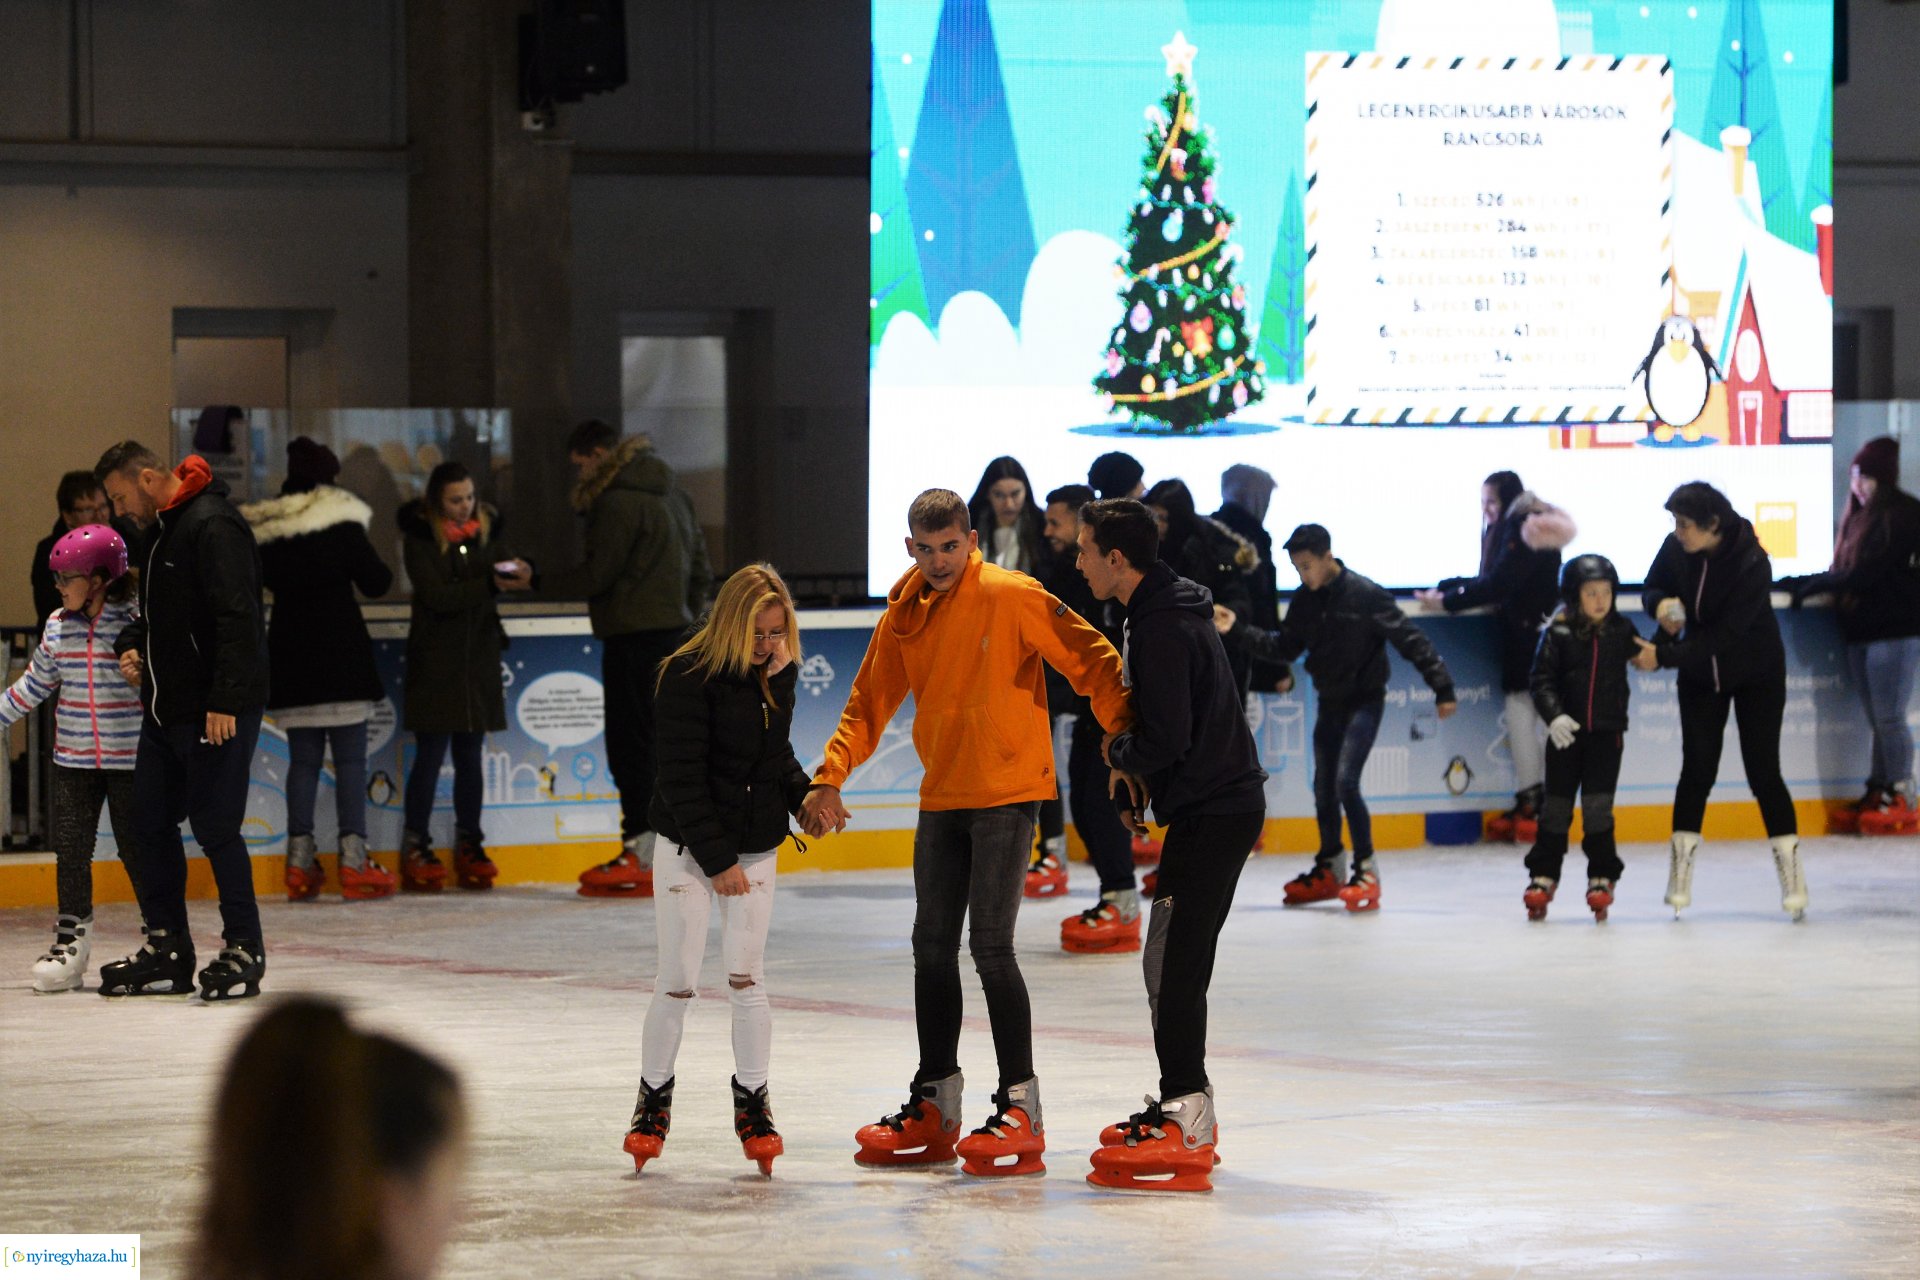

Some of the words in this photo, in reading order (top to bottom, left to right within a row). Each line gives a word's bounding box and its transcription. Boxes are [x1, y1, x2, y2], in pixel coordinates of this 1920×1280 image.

[1476, 192, 1504, 208] 526
[1497, 219, 1527, 233] 284
[1502, 271, 1527, 286] 132
[1513, 323, 1529, 337] 41
